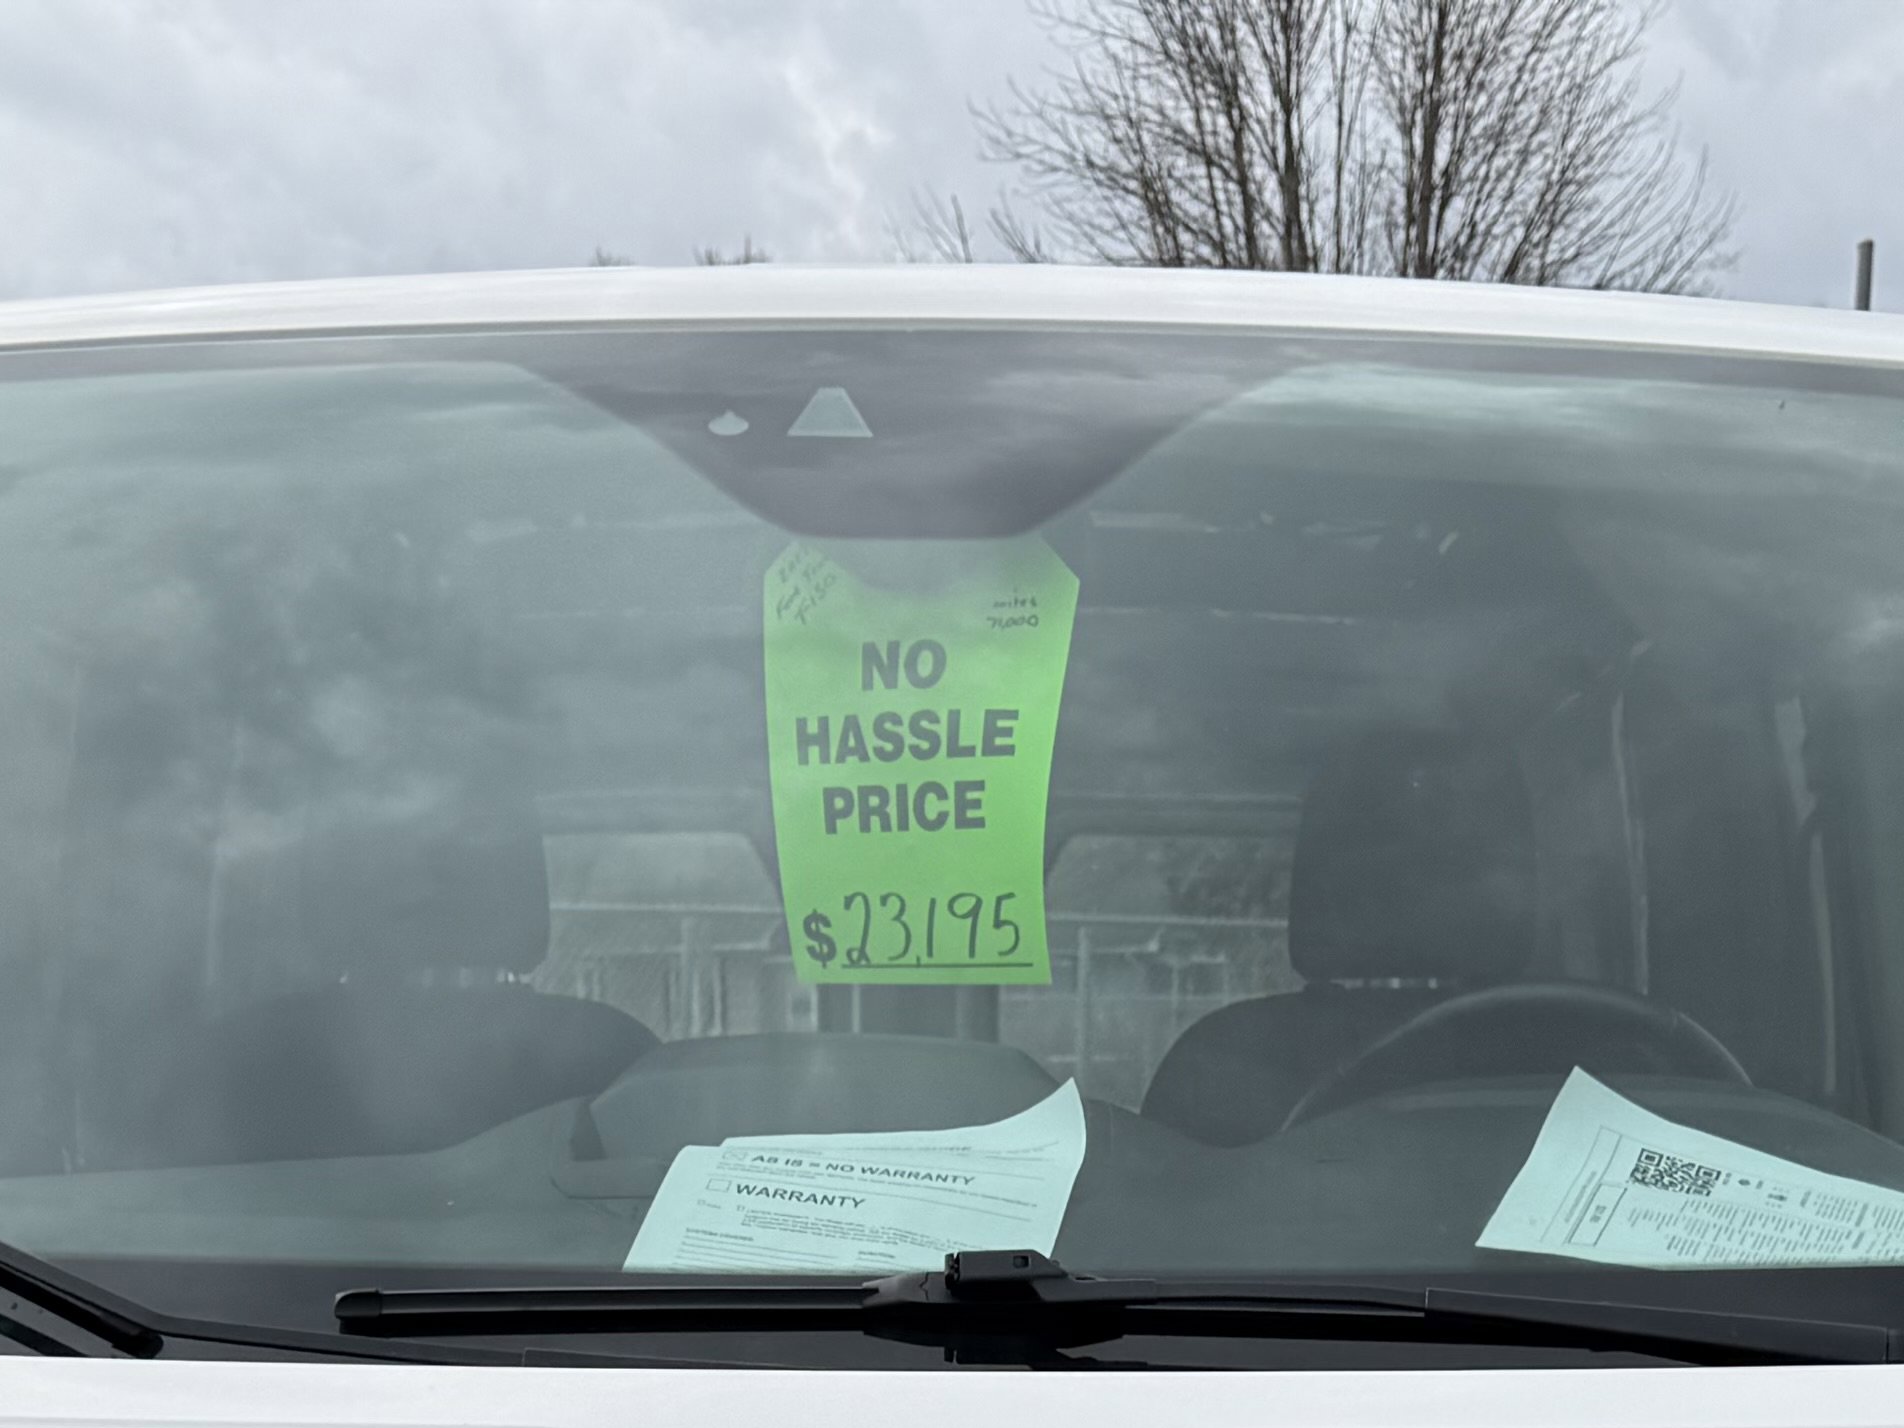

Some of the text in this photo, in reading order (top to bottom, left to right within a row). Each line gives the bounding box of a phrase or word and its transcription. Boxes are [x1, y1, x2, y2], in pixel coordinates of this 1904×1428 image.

[861, 639, 947, 691] NO
[795, 709, 1020, 765] HASSLE
[822, 780, 986, 835] PRICE
[735, 1183, 867, 1209] WARRANTY
[752, 1154, 779, 1165] AS
[784, 1157, 804, 1168] IS
[825, 1162, 856, 1173] NO
[860, 1165, 977, 1186] WARRANTY
